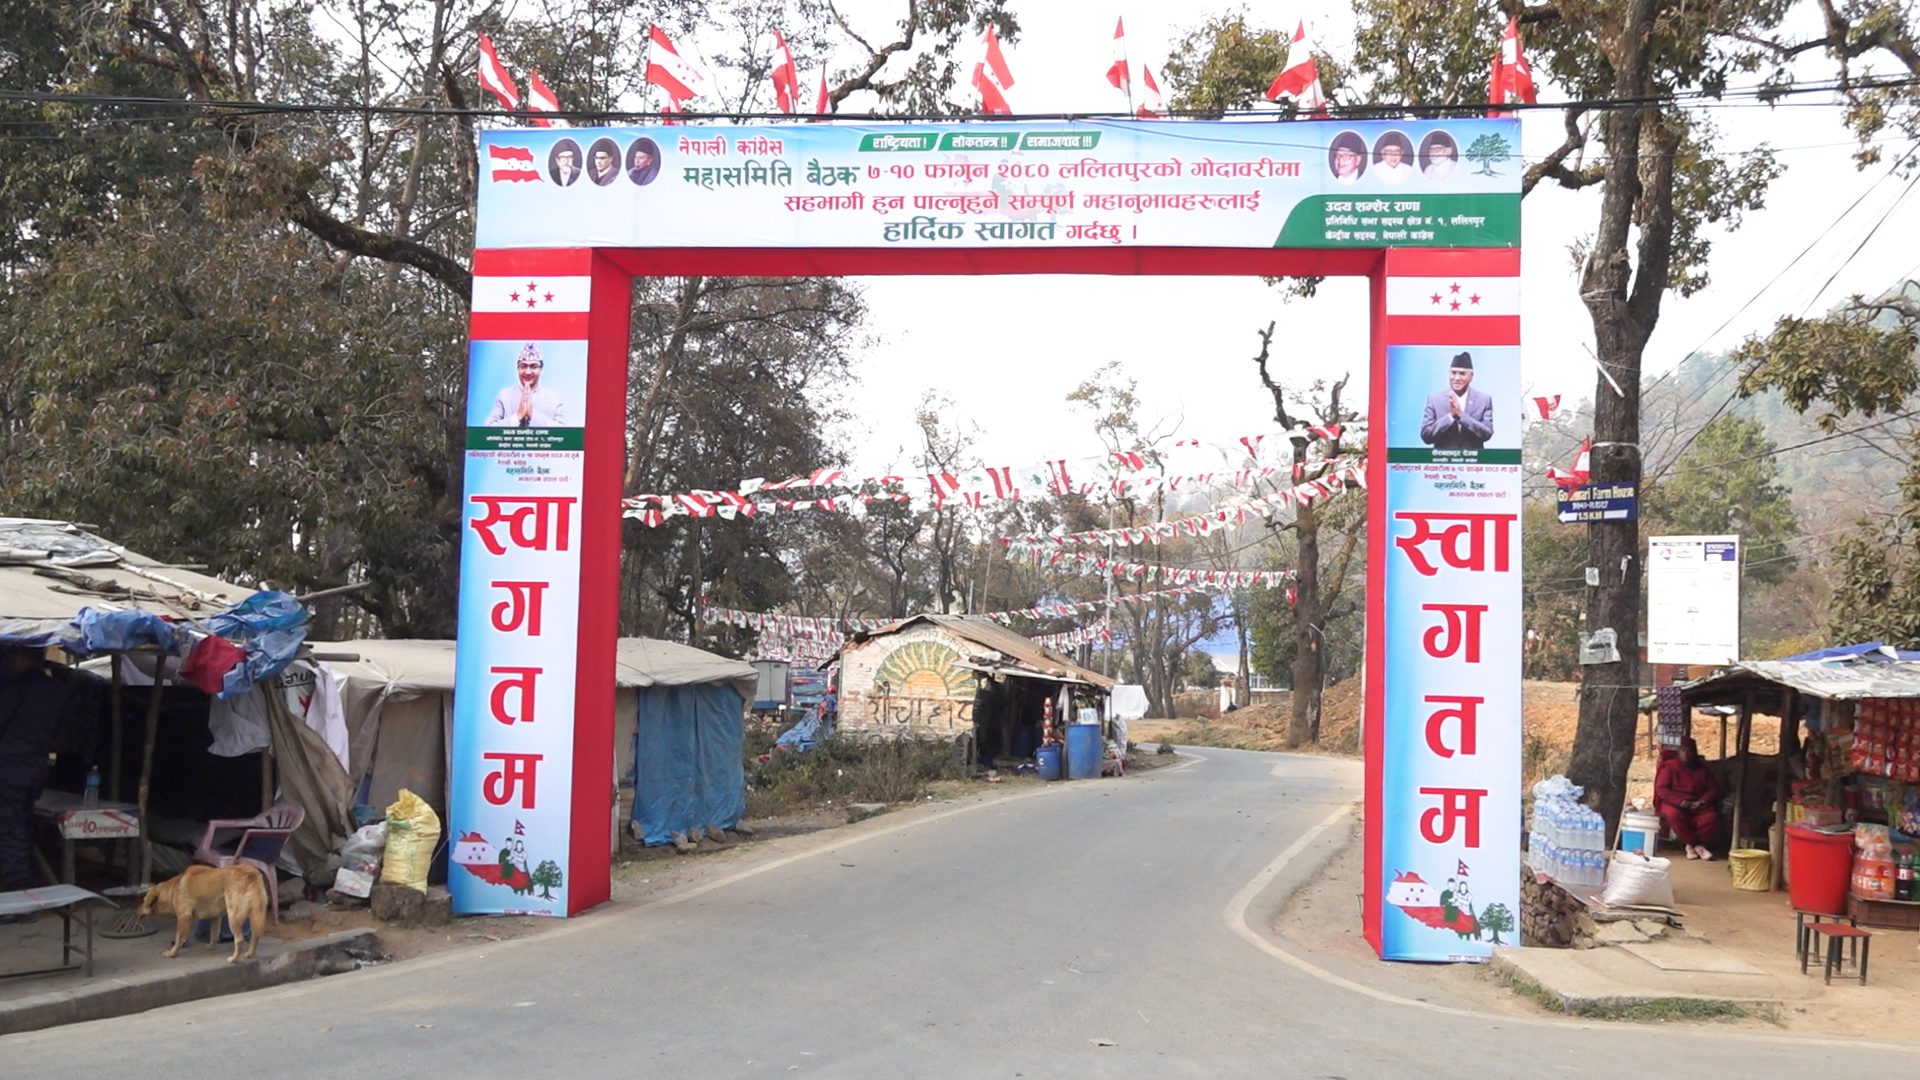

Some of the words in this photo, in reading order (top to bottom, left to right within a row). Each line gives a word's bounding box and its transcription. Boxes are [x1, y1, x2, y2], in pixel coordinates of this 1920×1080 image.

[679, 136, 727, 156] नेपाली
[737, 136, 783, 156] कांग्रेस
[683, 159, 792, 190] महासमिति
[806, 158, 861, 186] बैठक
[924, 162, 990, 183] फागुन
[997, 163, 1050, 179] २०८०
[1058, 158, 1183, 181] ललितपुरको
[1191, 157, 1301, 178] गोदावरीमा
[783, 191, 866, 213] सहभागी
[872, 195, 905, 214] हुन
[913, 190, 999, 214] पाल्नुहुने
[1008, 190, 1075, 214] सम्पूर्ण
[1324, 201, 1353, 212] उदय
[1393, 201, 1421, 212] राणा
[883, 215, 965, 242] हार्दिक
[974, 222, 1056, 241] स्वागत
[1066, 220, 1122, 244] गर्दछु
